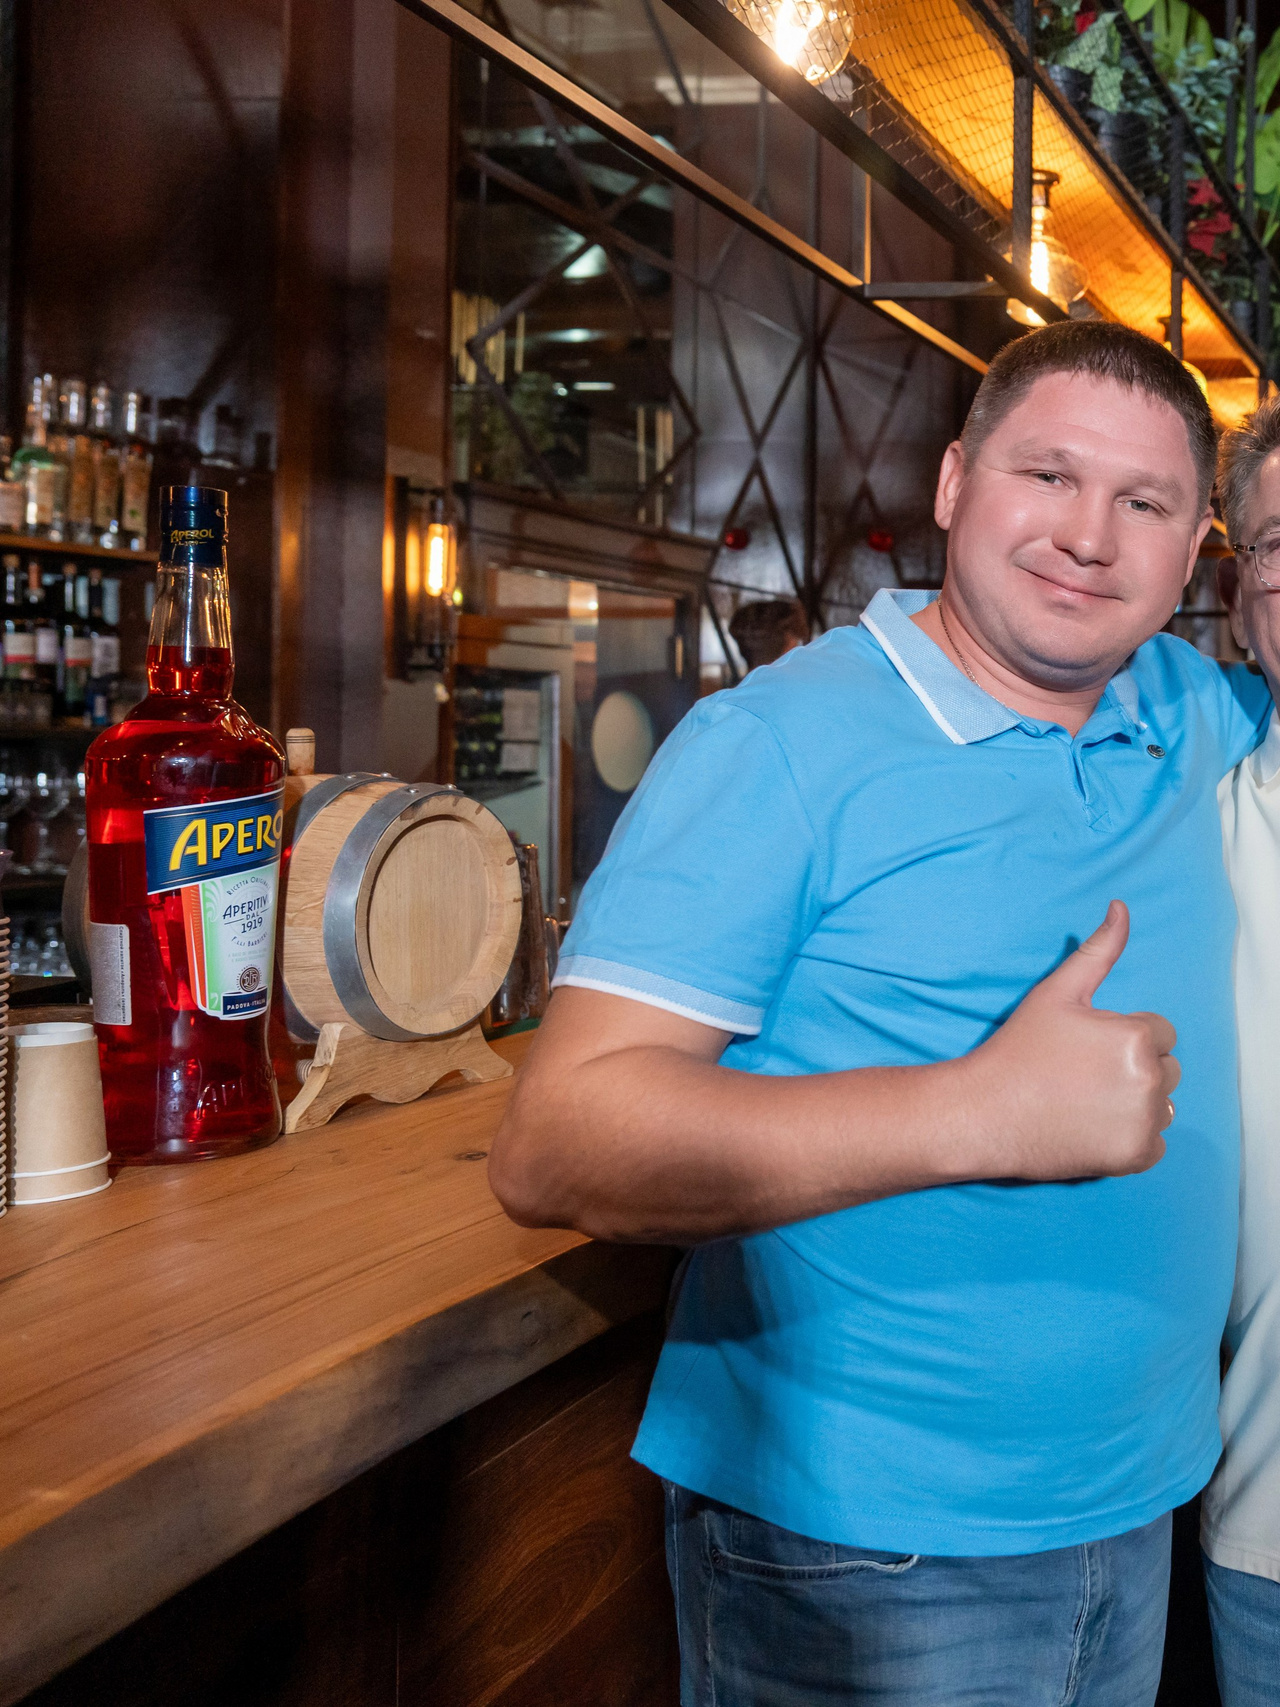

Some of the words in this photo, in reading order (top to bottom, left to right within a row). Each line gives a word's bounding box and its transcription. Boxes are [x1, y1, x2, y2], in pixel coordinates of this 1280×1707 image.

[171, 529, 214, 543] APEROL
[226, 879, 249, 896] RICETTA
[223, 894, 269, 919] APERITIV
[246, 911, 260, 921] DAL
[241, 917, 263, 934] 1919
